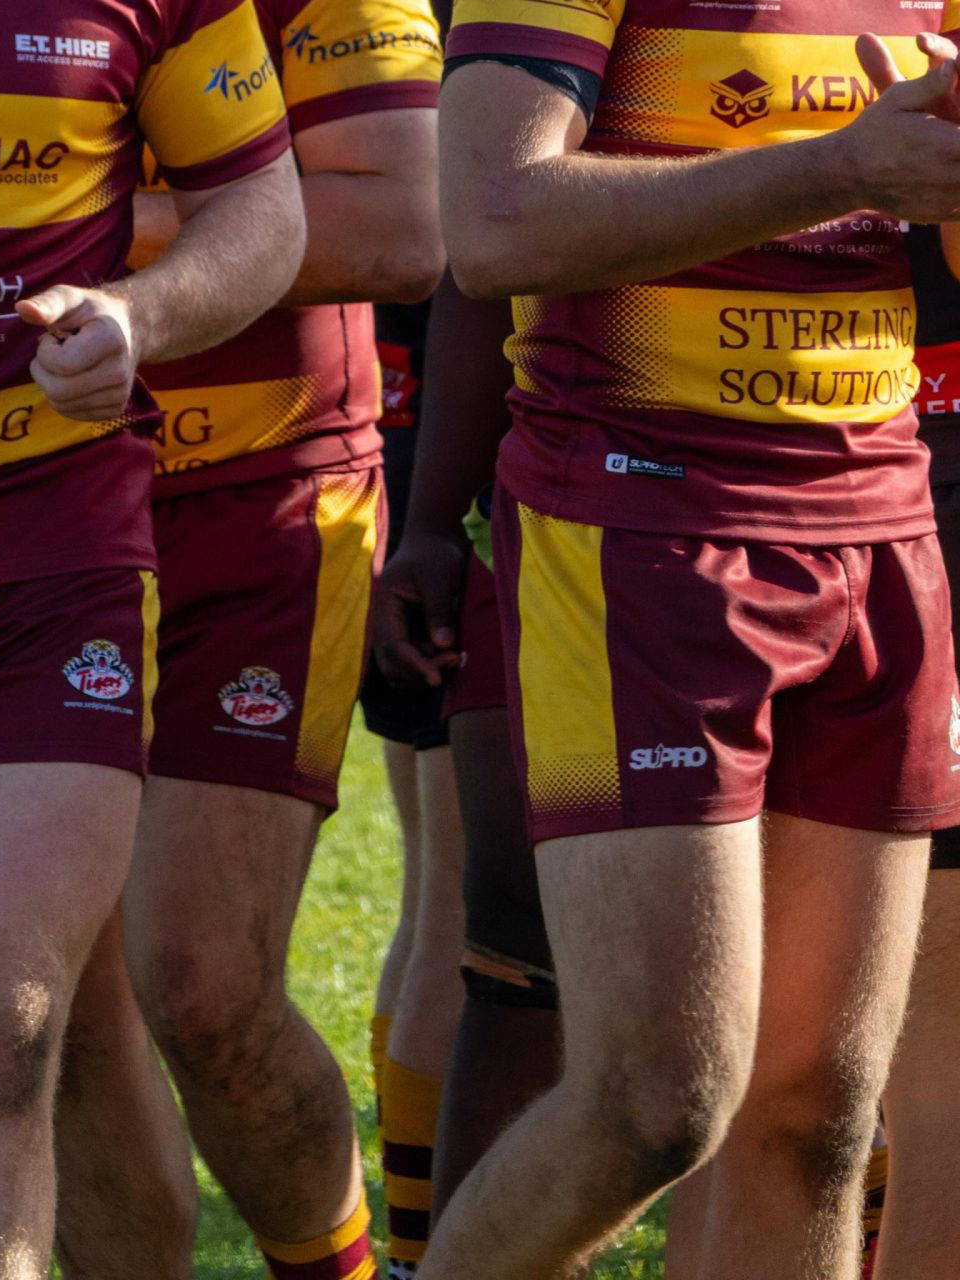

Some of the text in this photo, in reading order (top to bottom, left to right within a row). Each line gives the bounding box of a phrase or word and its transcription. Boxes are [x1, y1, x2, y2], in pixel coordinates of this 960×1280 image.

[54, 36, 111, 60] HIRE
[309, 30, 397, 64] north
[850, 220, 873, 232] CO
[718, 306, 913, 351] STERLING
[76, 668, 123, 692] Tigers
[629, 743, 708, 770] SUPRO
